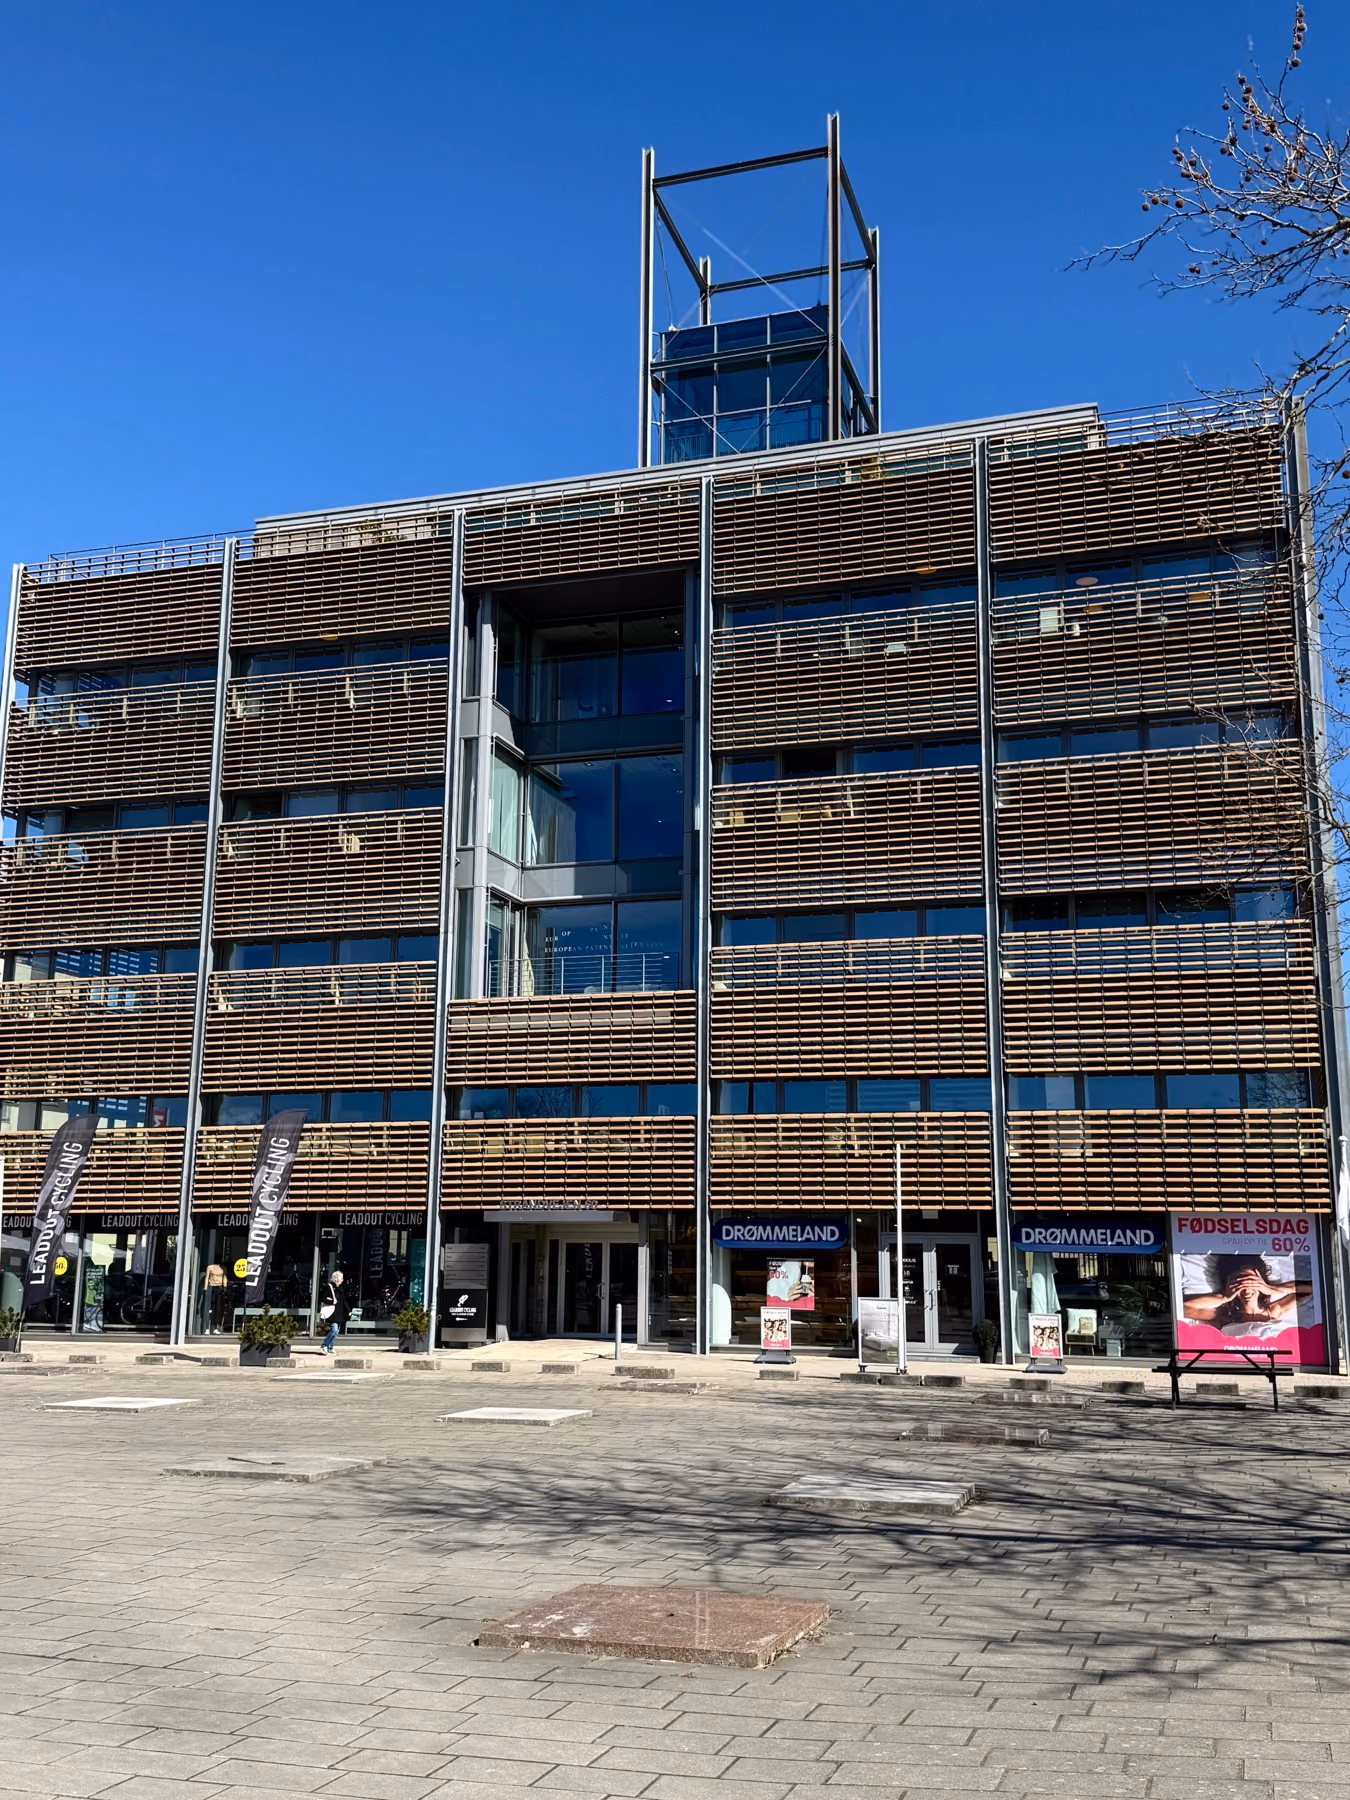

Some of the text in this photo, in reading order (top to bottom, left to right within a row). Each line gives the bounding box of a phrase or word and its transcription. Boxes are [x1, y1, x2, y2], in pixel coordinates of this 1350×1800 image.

[259, 1137, 290, 1204] CYCLING
[30, 1142, 83, 1285] LEADOUT CYCLING
[102, 1214, 179, 1227] LEADOUT CYCLING
[218, 1213, 250, 1227] LEADO
[339, 1212, 423, 1226] LEADOUT CYCLING
[2, 1216, 35, 1228] EADOU
[1177, 1216, 1309, 1235] FØDSELSDAG
[722, 1225, 839, 1241] DRØMMELAND
[1021, 1228, 1155, 1246] DRØMMELAND
[245, 1206, 275, 1287] LEADOUT
[1271, 1237, 1310, 1253] 60%
